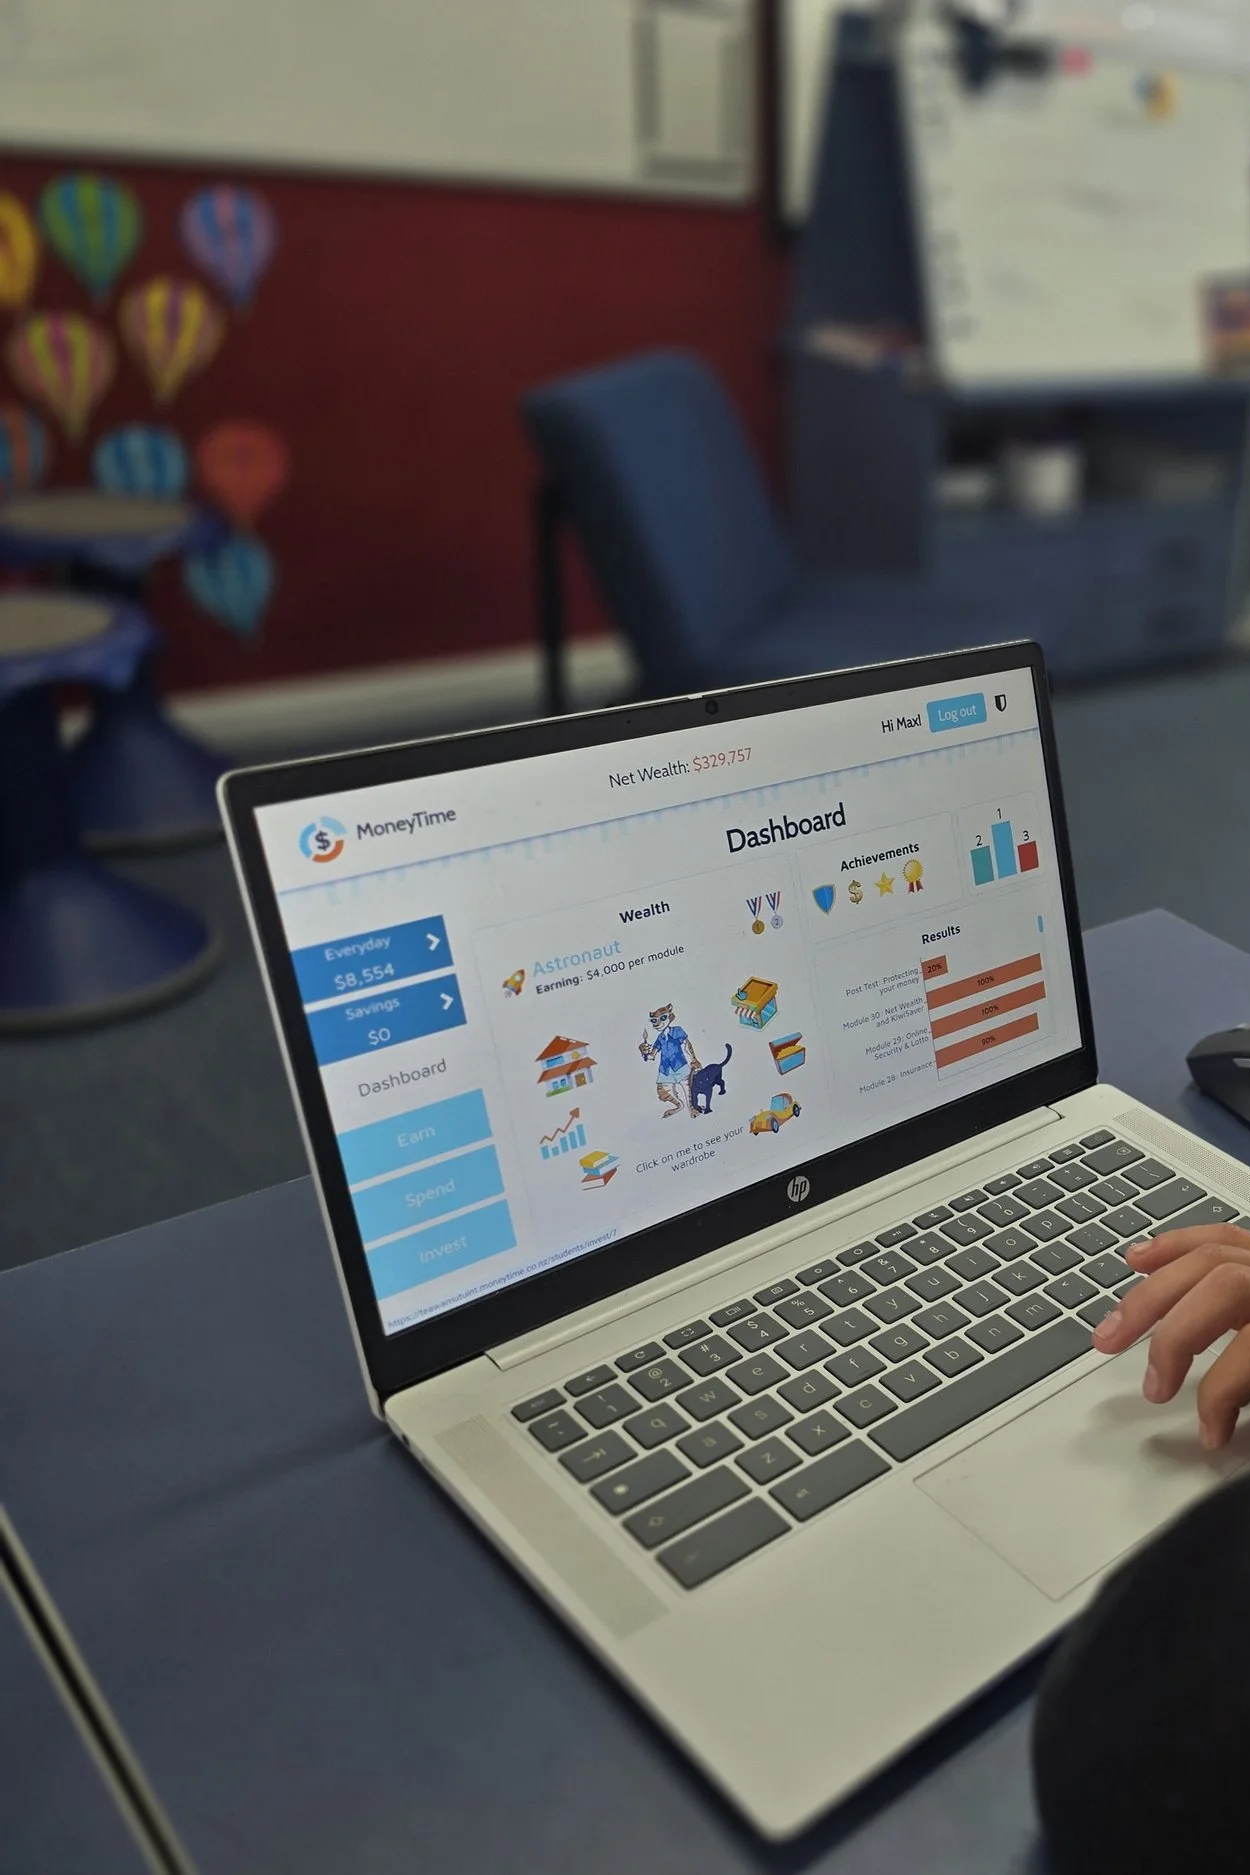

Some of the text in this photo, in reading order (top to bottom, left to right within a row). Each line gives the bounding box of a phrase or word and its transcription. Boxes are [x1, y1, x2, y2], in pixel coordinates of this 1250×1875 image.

[881, 719, 895, 733] Hi
[938, 704, 977, 723] Log out
[609, 747, 753, 788] Net Wealth: $329,757
[357, 809, 457, 839] MoneyTime
[996, 808, 1003, 820] 1
[726, 802, 846, 853] Dashboard
[1023, 830, 1031, 841] 3
[975, 835, 983, 846] 2
[840, 842, 920, 871] Achievements
[619, 901, 671, 924] Wealth
[922, 925, 961, 944] Results
[324, 936, 391, 962] Everyday
[532, 940, 622, 976] Astronaut
[334, 963, 395, 991] $8,554
[535, 944, 684, 994] Earning: $4,000 per module
[927, 963, 943, 973] 20%
[845, 985, 863, 997] Post
[883, 968, 919, 984] Protecting
[879, 976, 920, 997] your money
[976, 975, 995, 987] 100%
[345, 997, 400, 1020] Savings
[843, 1015, 869, 1031] Module
[885, 1004, 898, 1016] Net
[899, 997, 924, 1011] Wealth
[876, 1005, 924, 1028] and KiwiSaver
[981, 1004, 1000, 1016] 100%
[368, 1028, 391, 1046] $0
[865, 1040, 891, 1055] Module
[906, 1028, 928, 1041] Online
[874, 1044, 903, 1062] Security
[910, 1035, 929, 1048] Lotto
[981, 1035, 997, 1046] 90%
[358, 1058, 448, 1098] Dashboard
[859, 1078, 885, 1094] Module
[900, 1060, 933, 1078] Insurance
[397, 1125, 436, 1148] Earn
[636, 1126, 744, 1174] Click on me to see your
[671, 1149, 716, 1173] wardrobe
[405, 1179, 456, 1208] Spend
[419, 1235, 468, 1264] Invest
